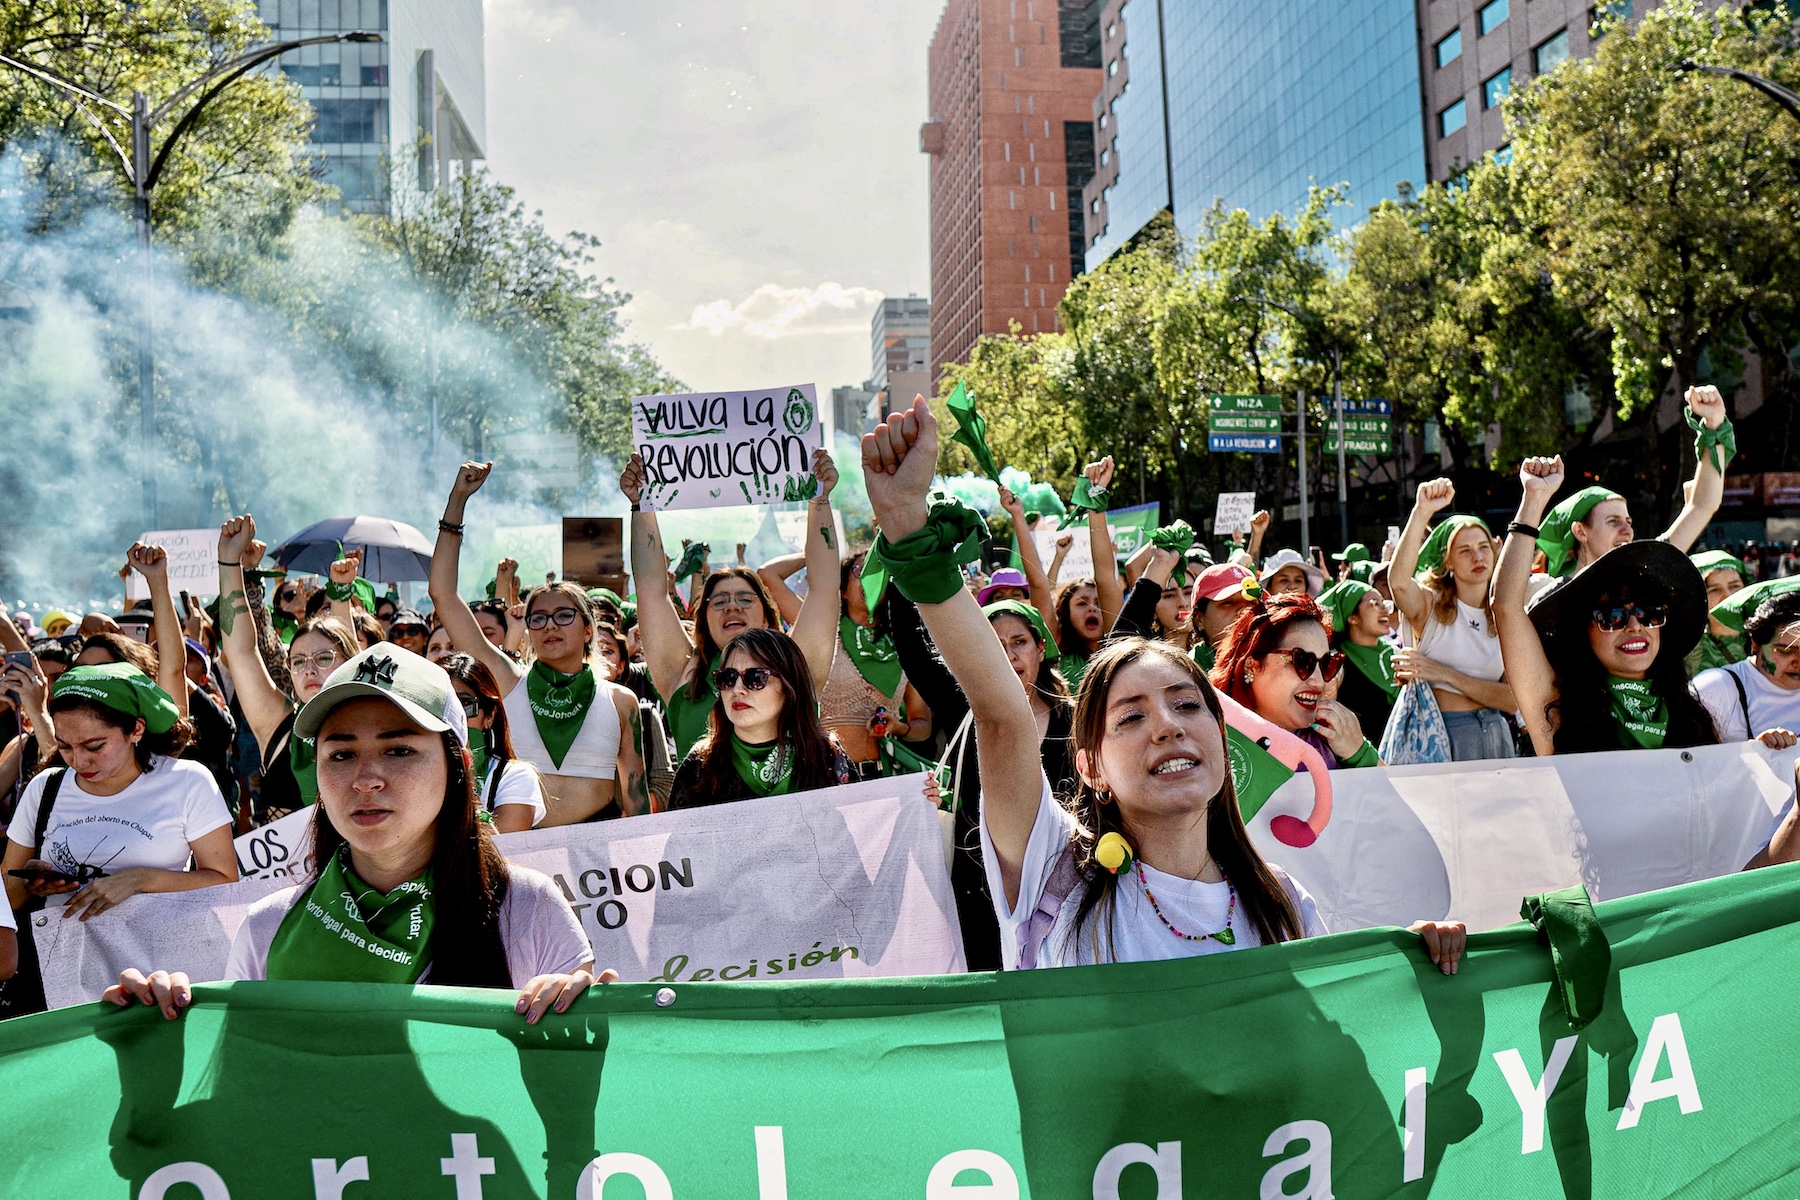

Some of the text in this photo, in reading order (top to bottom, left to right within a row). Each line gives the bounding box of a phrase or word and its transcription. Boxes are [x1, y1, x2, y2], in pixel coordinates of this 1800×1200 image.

[1237, 398, 1264, 408] NIZA
[1329, 421, 1357, 431] ANONIO
[85, 815, 97, 824] del
[97, 815, 120, 823] aborto
[130, 822, 154, 840] Chiapas
[321, 911, 342, 933] legal
[340, 926, 365, 948] para
[368, 942, 412, 966] decidir.
